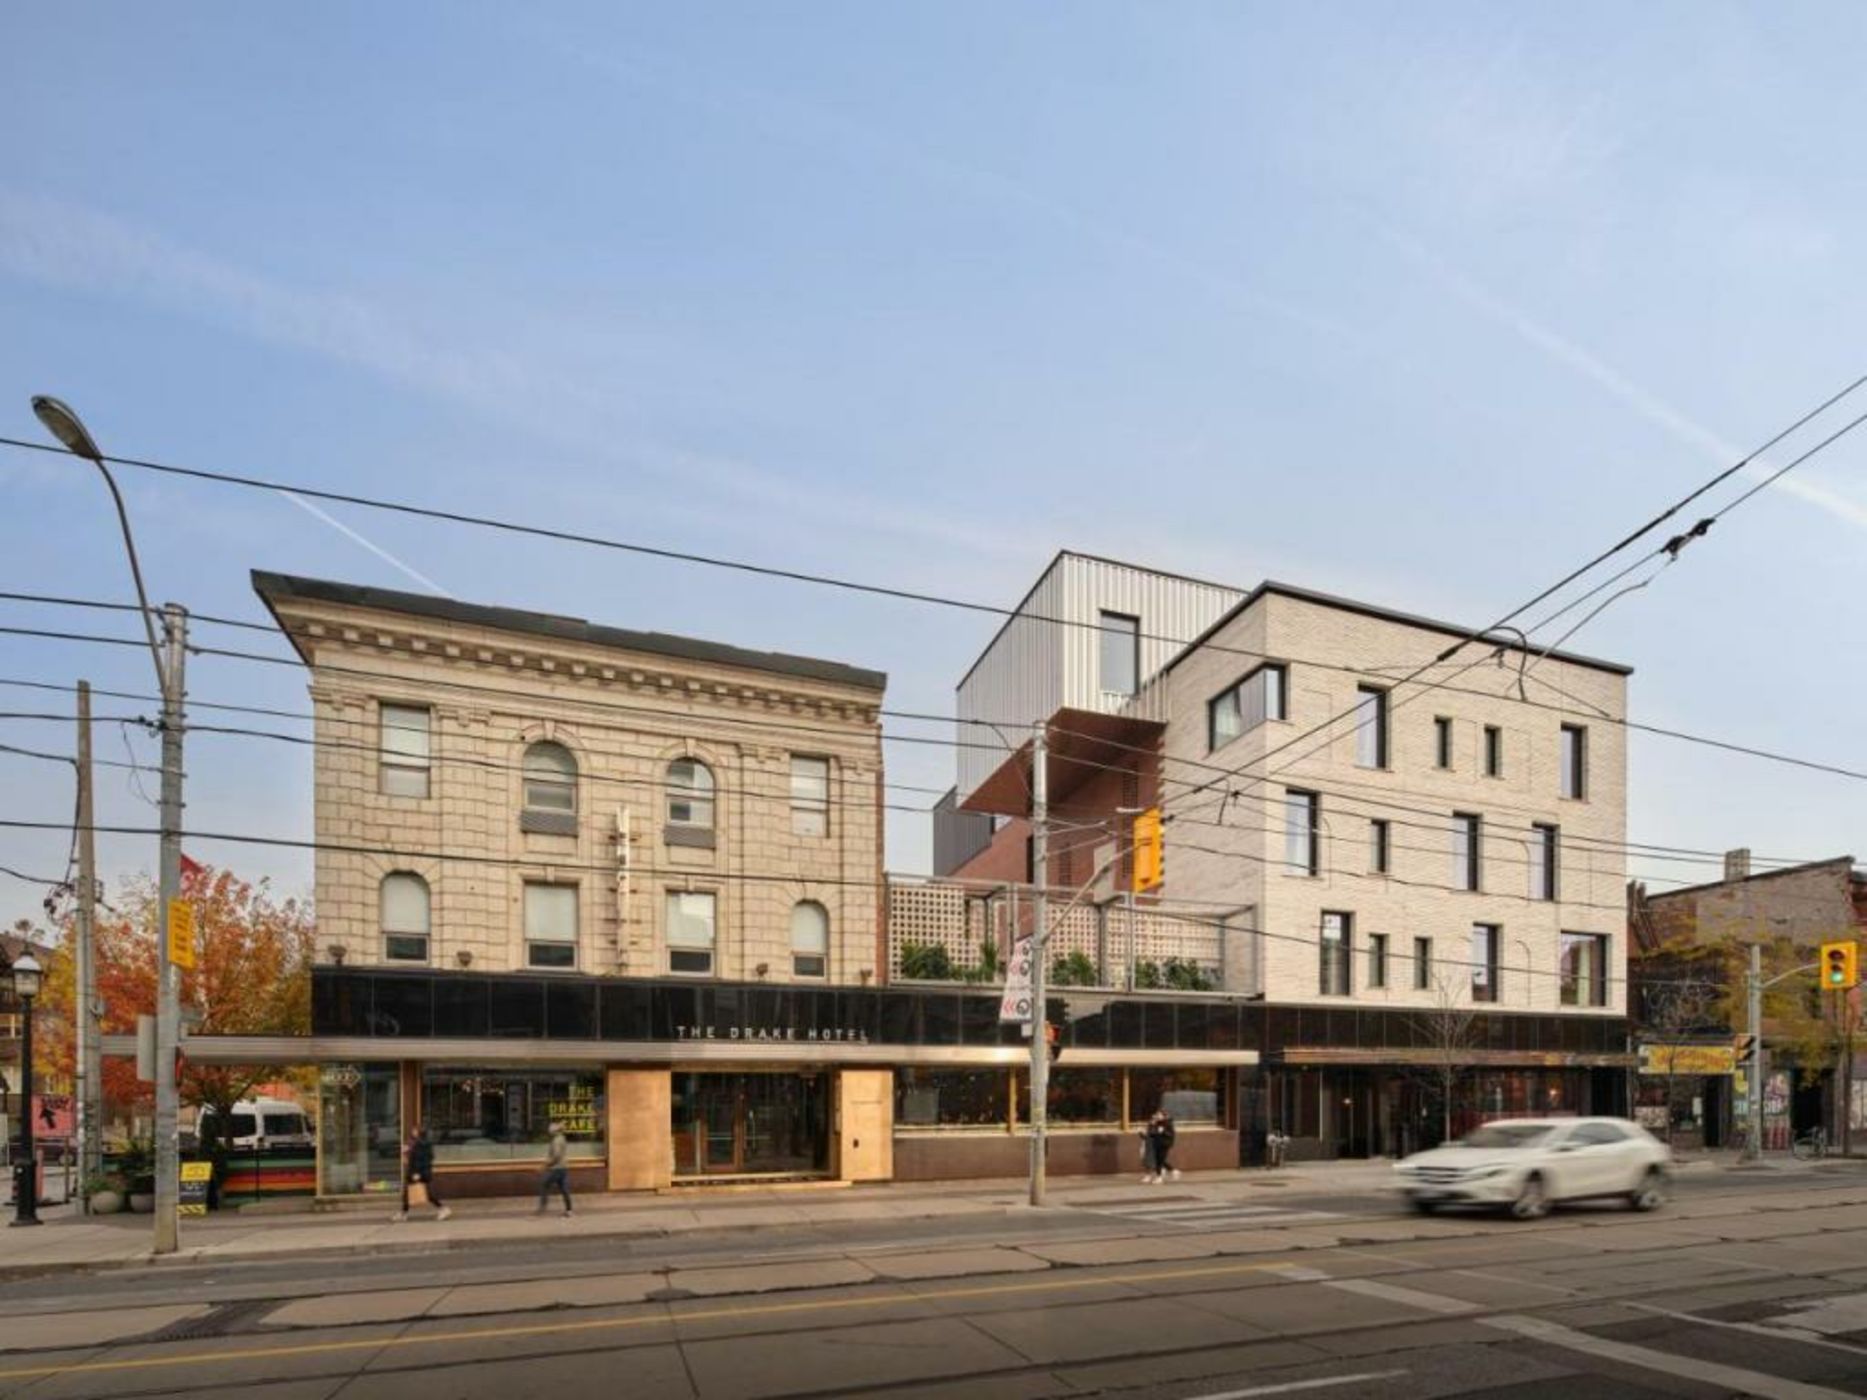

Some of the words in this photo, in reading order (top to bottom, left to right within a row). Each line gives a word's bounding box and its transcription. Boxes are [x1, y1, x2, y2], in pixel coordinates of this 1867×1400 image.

[676, 1025, 716, 1039] THE
[730, 1026, 796, 1041] DRAKE
[808, 1028, 869, 1043] HOTEL
[568, 1086, 595, 1098] THE
[548, 1103, 594, 1114] DRAKE
